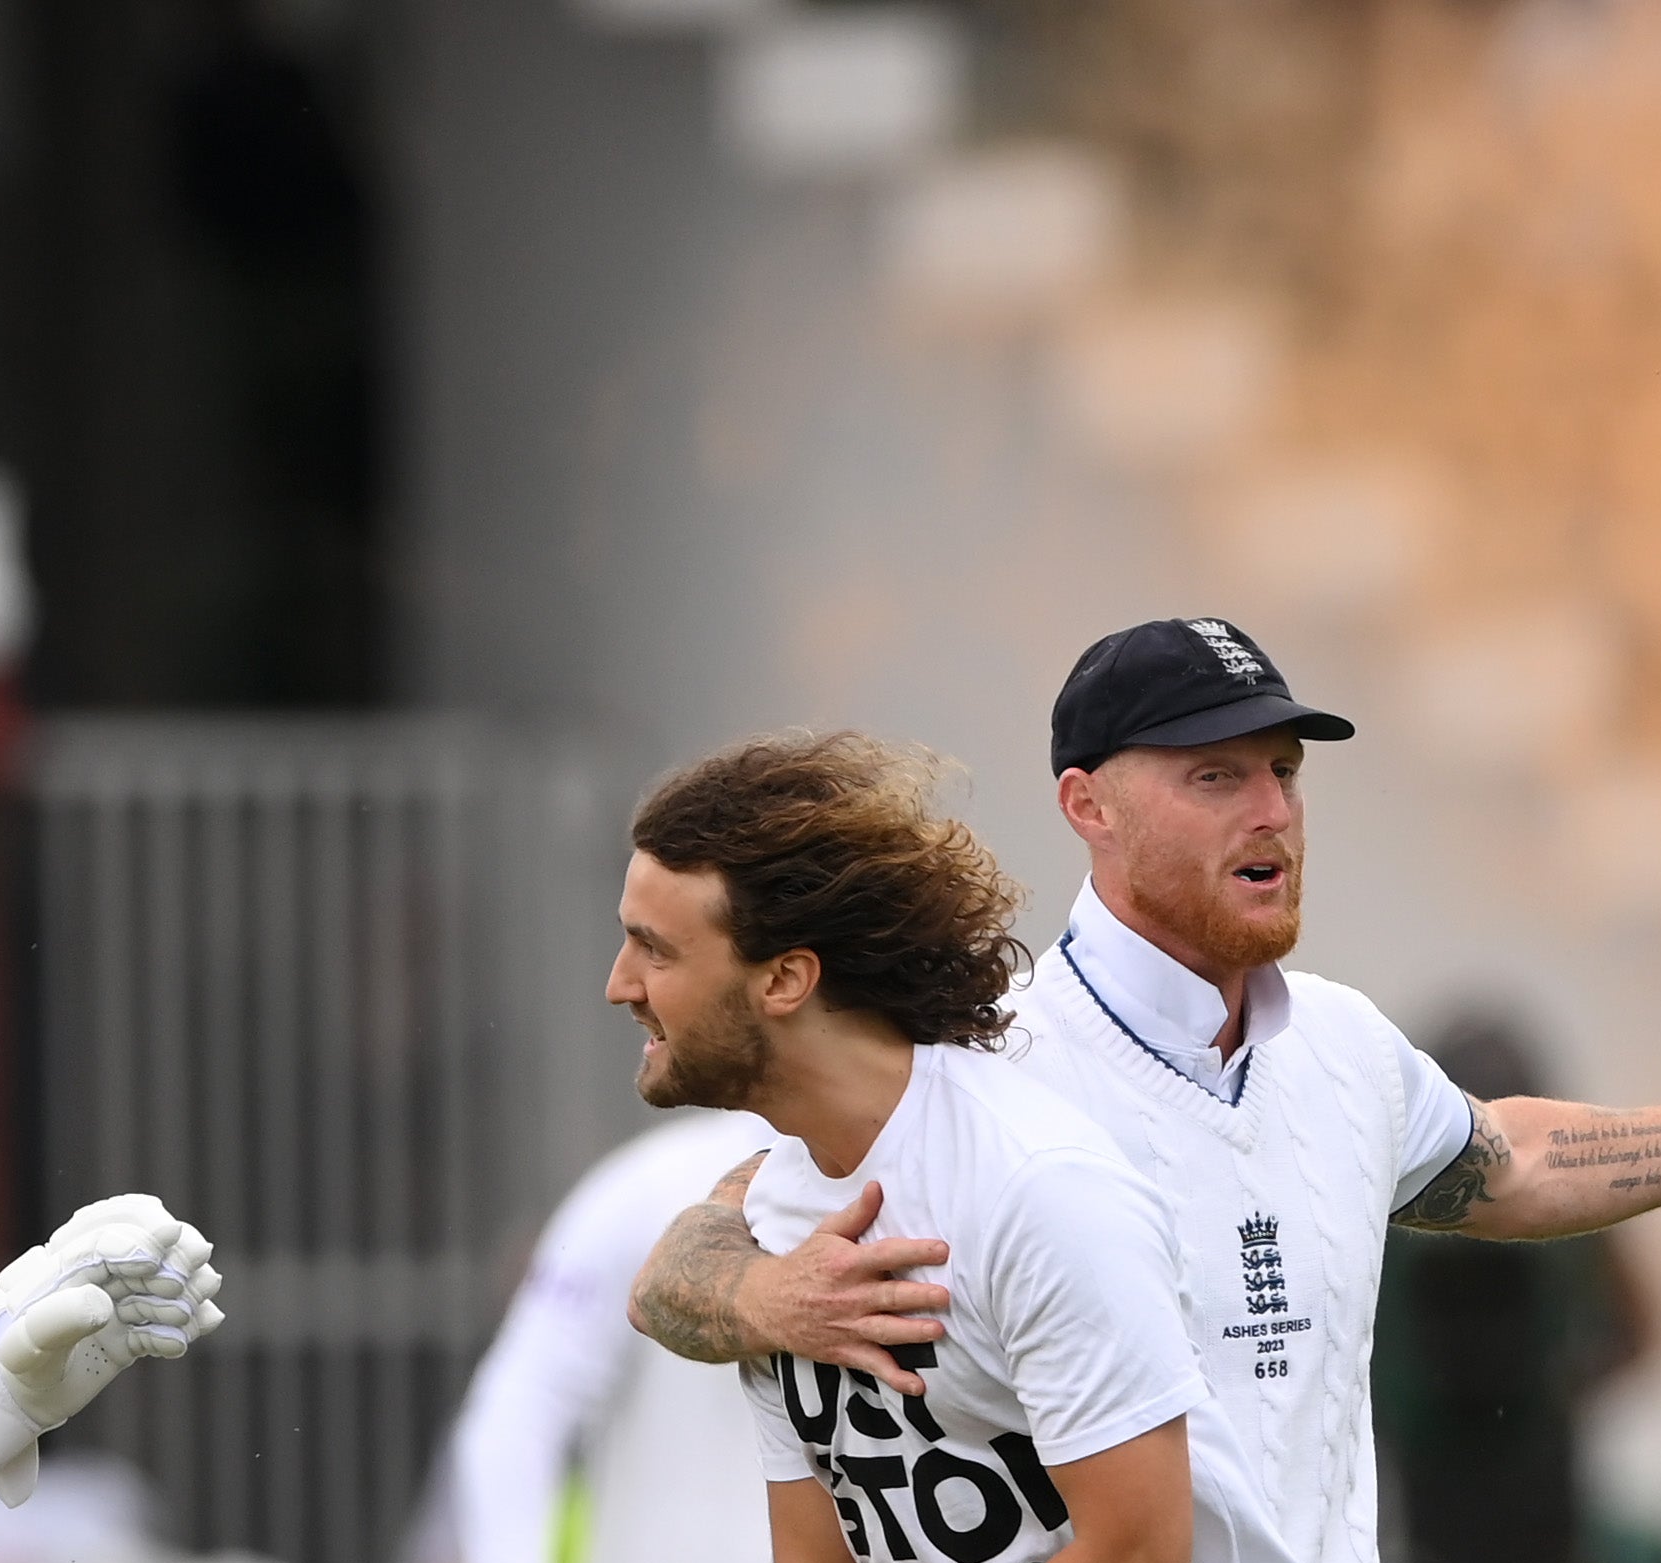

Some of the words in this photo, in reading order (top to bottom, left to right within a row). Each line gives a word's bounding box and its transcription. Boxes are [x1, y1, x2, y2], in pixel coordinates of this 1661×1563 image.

[1221, 1323, 1268, 1339] ASHES
[1270, 1318, 1312, 1334] SERIES
[1256, 1339, 1285, 1354] 2023
[1254, 1360, 1288, 1379] 658
[770, 1342, 947, 1446] UST
